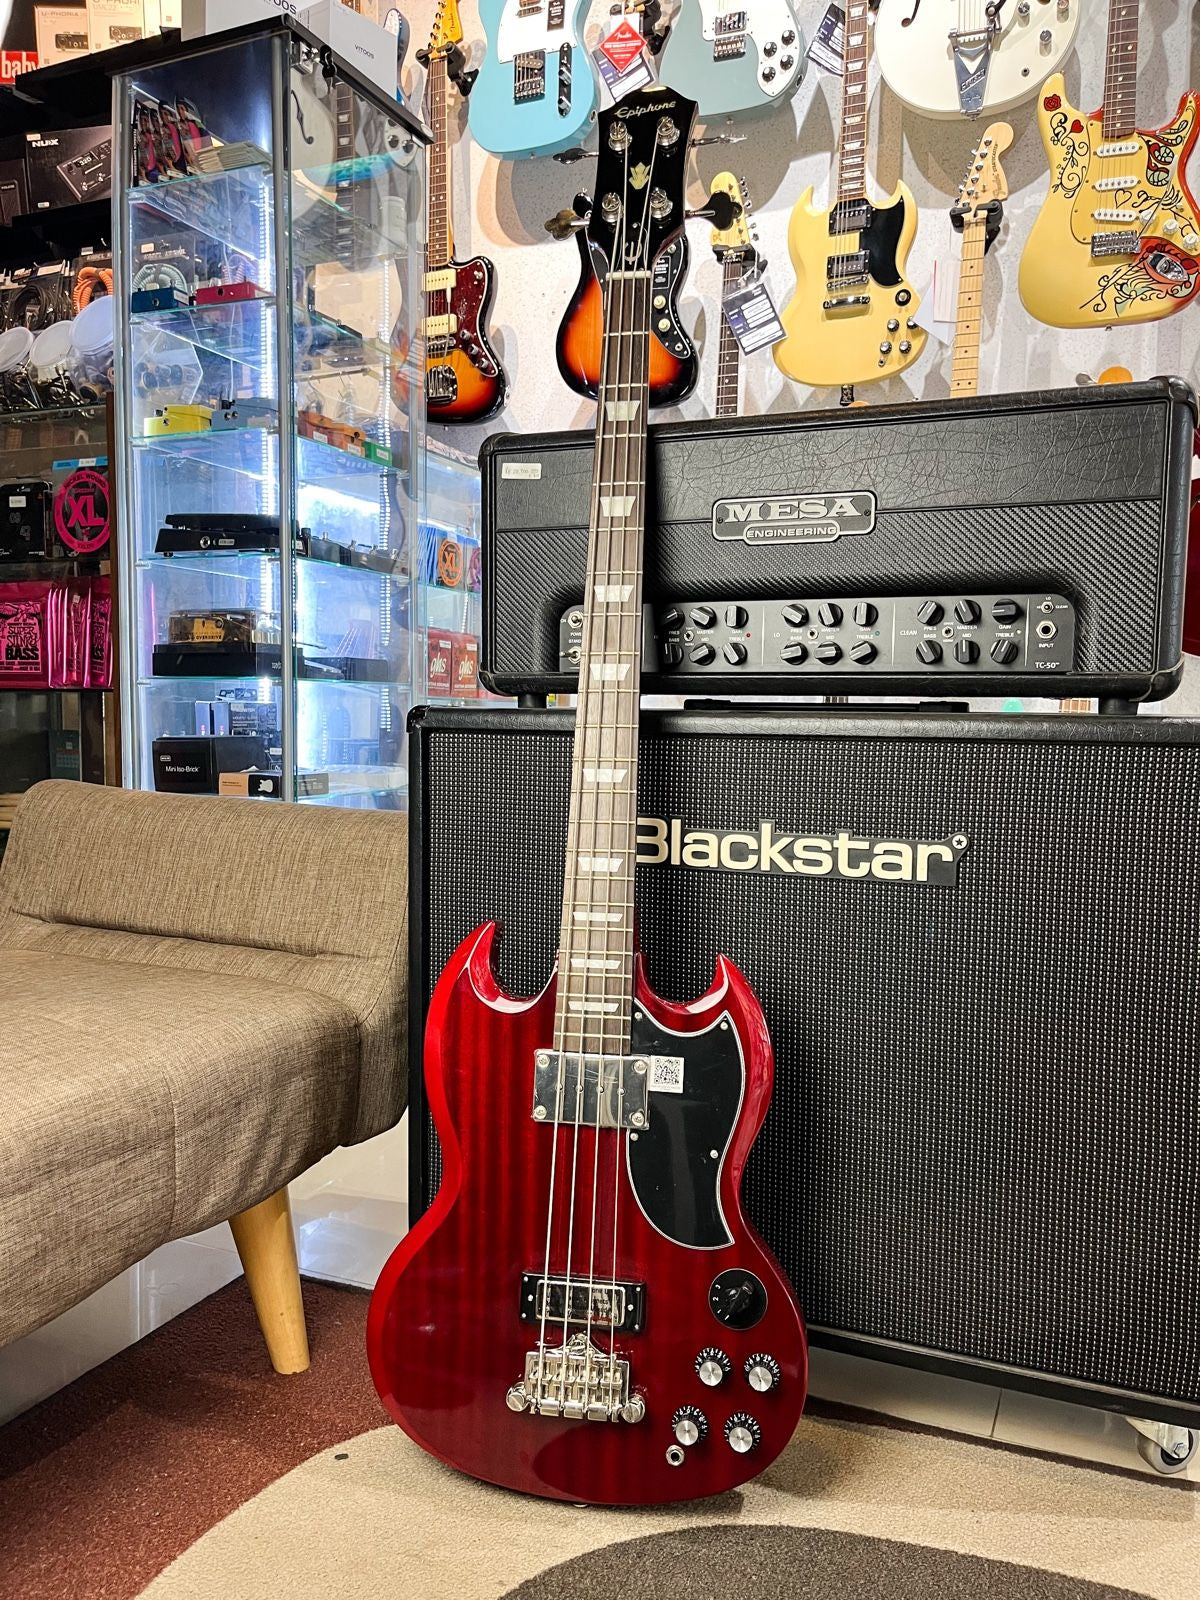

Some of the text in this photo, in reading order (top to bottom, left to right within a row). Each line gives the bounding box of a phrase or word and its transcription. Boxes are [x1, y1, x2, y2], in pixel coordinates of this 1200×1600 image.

[614, 101, 677, 119] Epiphone
[67, 495, 105, 528] XL
[724, 498, 862, 523] MESA
[746, 527, 837, 539] ENGINEERING
[8, 626, 35, 635] SUPER
[5, 647, 40, 661] BASS
[430, 652, 447, 678] ghs
[458, 655, 474, 681] ghs
[636, 816, 954, 882] Blackstar
